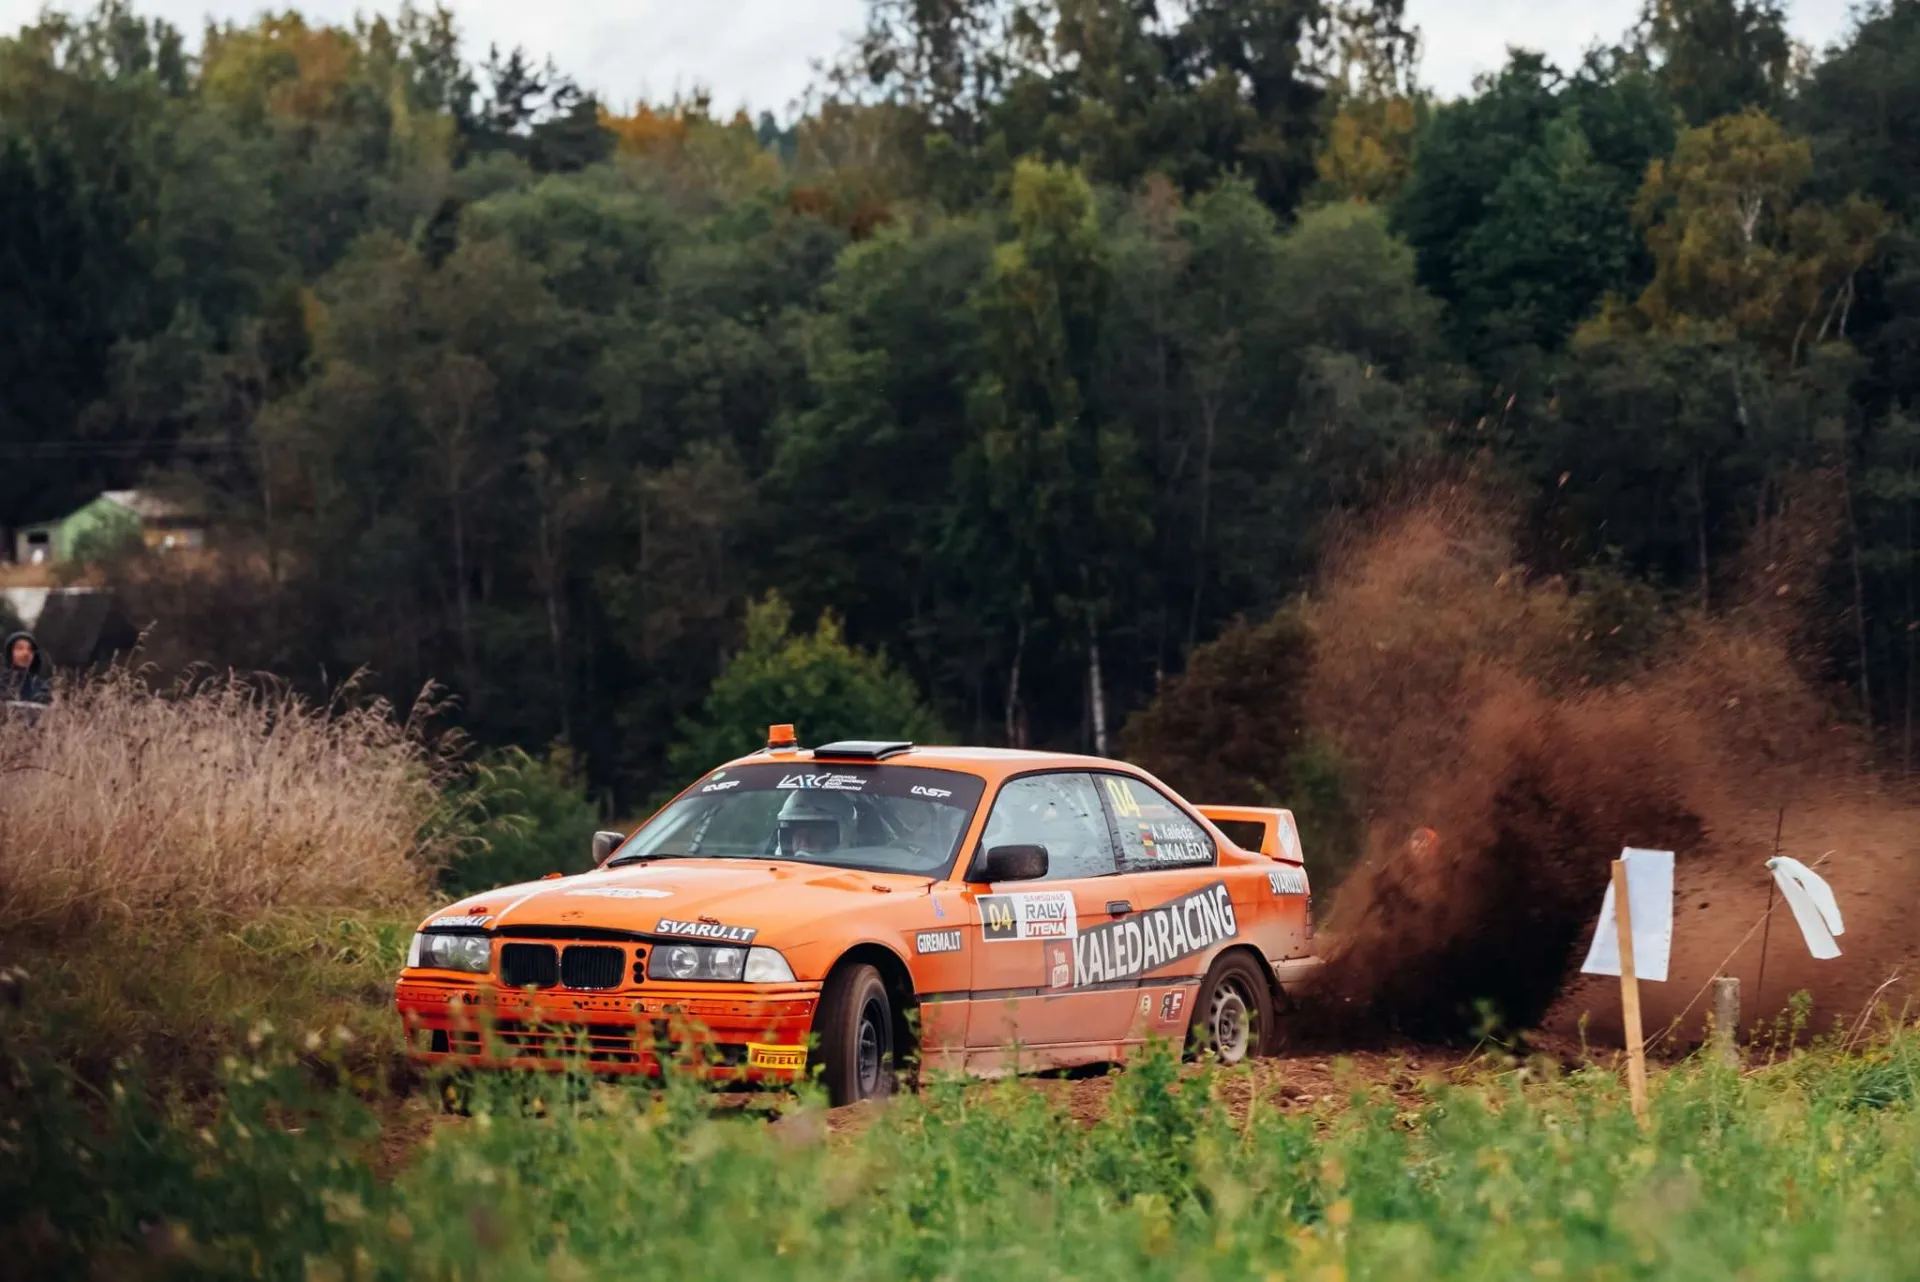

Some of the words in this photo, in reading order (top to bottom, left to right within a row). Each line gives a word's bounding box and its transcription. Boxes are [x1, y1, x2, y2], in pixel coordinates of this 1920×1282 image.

[1105, 778, 1142, 818] 04
[988, 903, 1013, 932] 04
[1025, 902, 1065, 919] RALLY
[656, 919, 756, 941] SVARU.LT
[1026, 922, 1066, 936] UTENA
[1072, 884, 1236, 988] KALEDARACING
